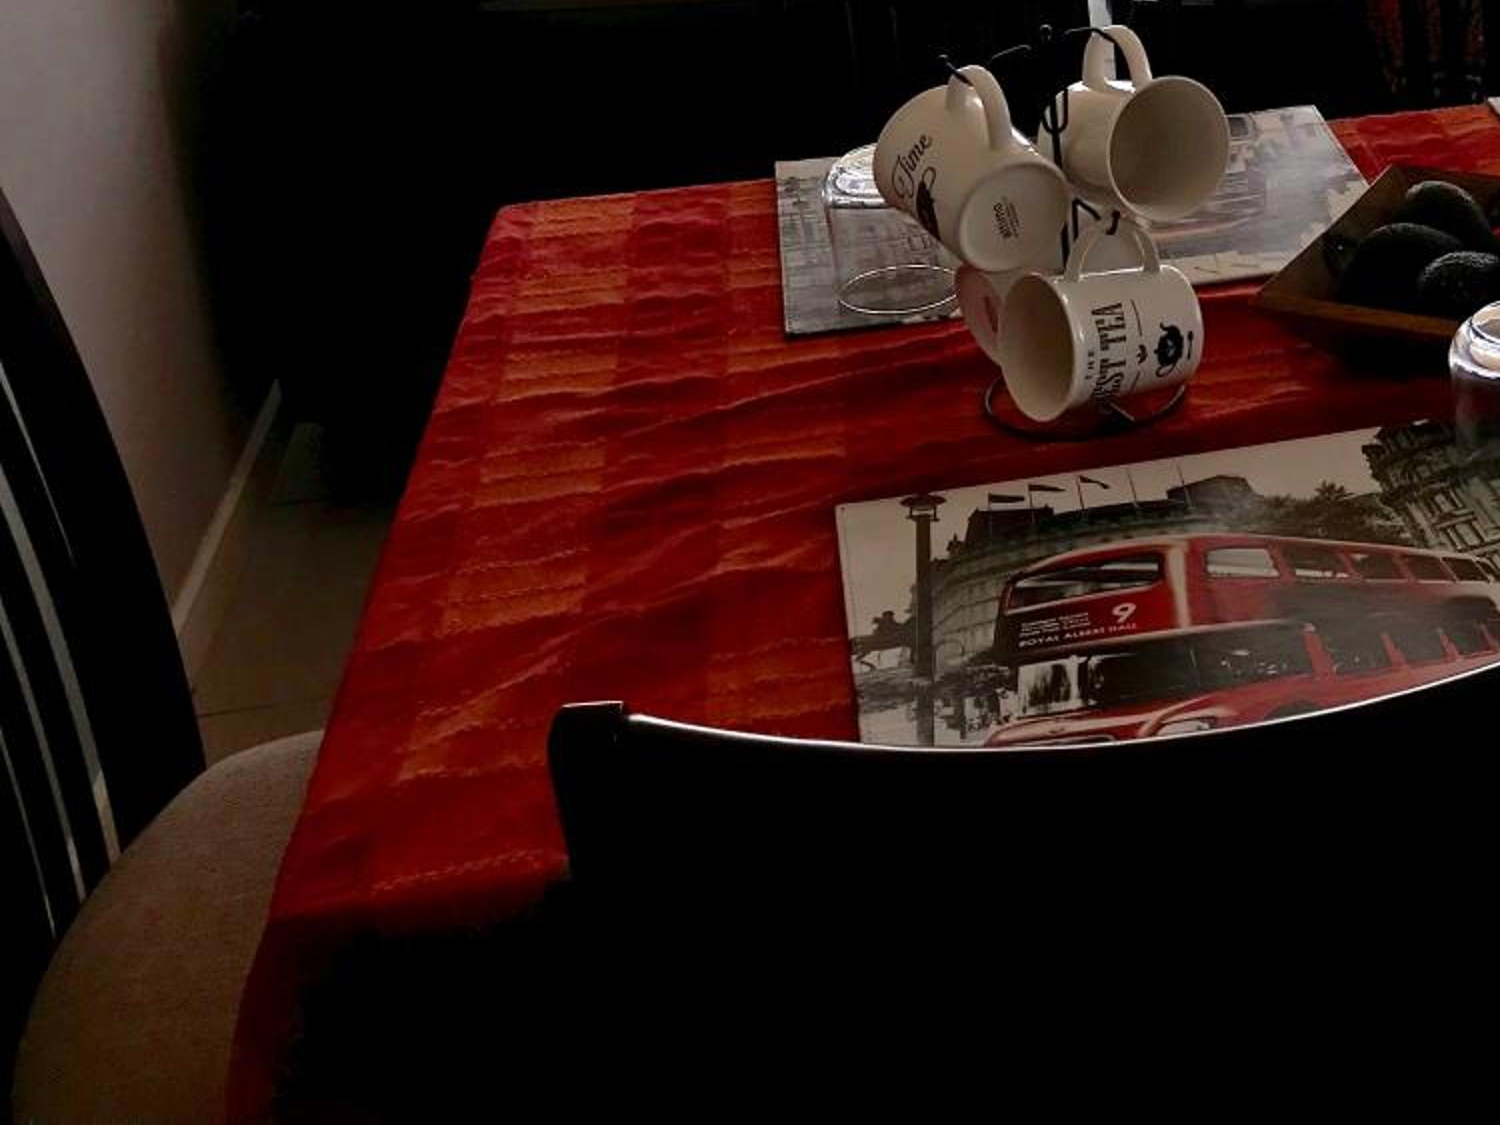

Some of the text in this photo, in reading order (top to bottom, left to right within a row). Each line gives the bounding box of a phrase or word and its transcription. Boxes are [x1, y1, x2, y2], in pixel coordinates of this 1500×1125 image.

[892, 134, 932, 198] Time
[1091, 302, 1127, 351] TEA
[1112, 602, 1137, 624] 9
[1018, 622, 1137, 648] ROYAL ALBERT HALL
